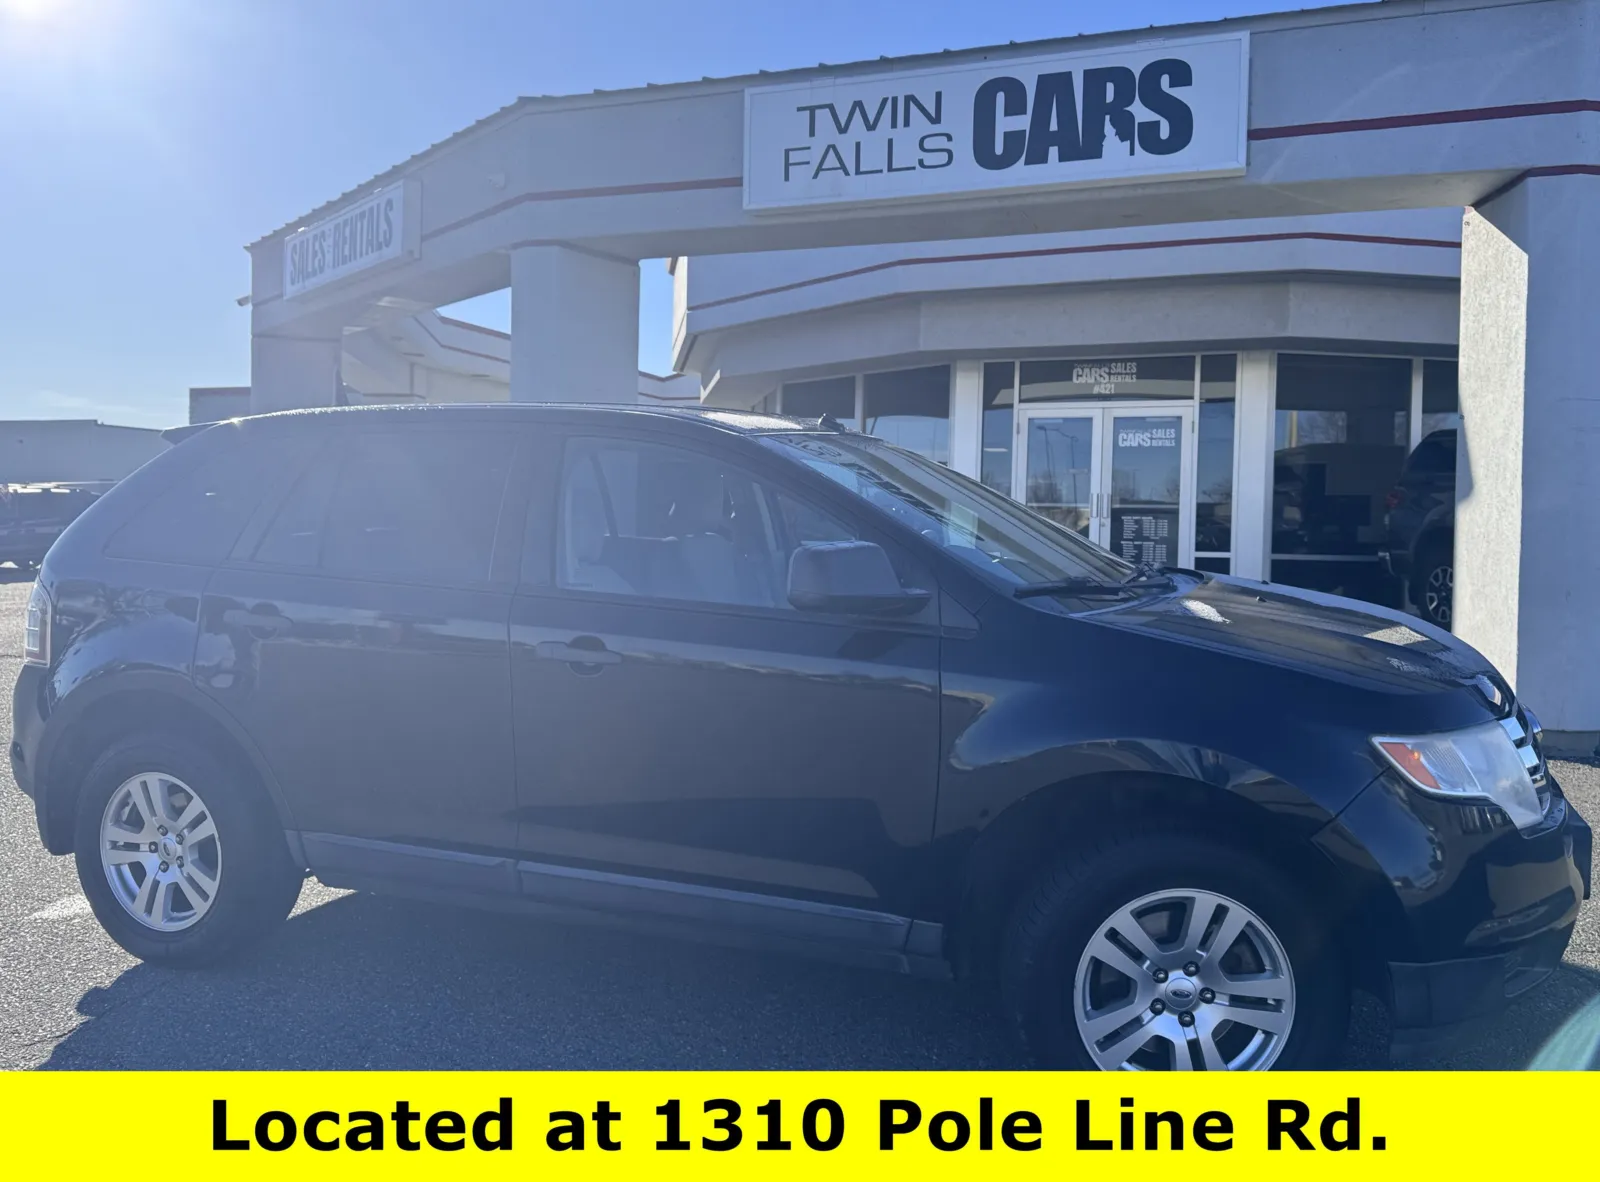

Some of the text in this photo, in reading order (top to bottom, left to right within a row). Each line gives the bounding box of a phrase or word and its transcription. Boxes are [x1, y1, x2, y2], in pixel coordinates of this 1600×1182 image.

[797, 90, 942, 138] TWIN
[972, 58, 1193, 171] CARS
[783, 132, 954, 182] FALLS
[290, 198, 394, 287] SALES RENTALS
[1072, 367, 1109, 384] CARS
[1110, 362, 1137, 374] SALES
[1110, 374, 1137, 383] RENTALS
[1118, 428, 1176, 447] CARS SALES
